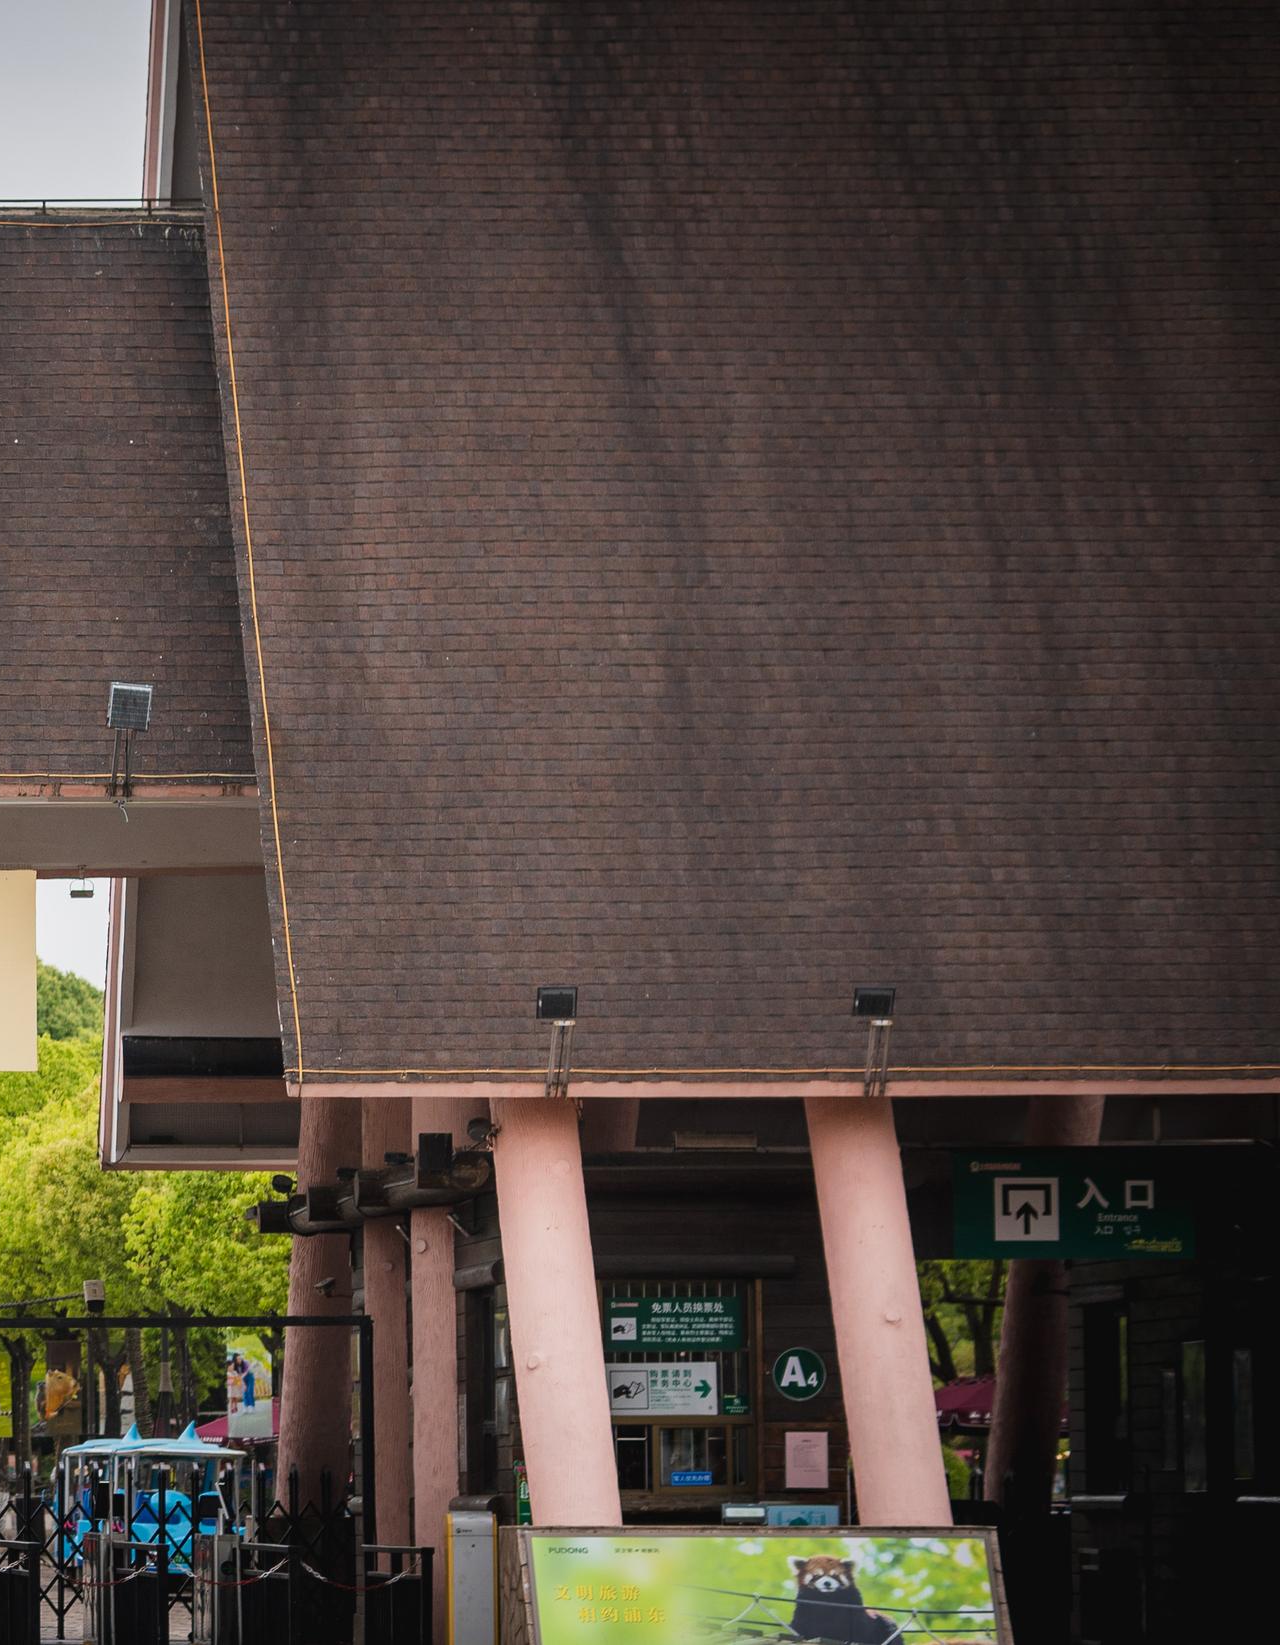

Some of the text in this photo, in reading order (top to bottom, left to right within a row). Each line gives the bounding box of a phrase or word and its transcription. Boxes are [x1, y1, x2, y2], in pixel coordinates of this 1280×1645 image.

[1076, 1177, 1156, 1210] 入口
[1097, 1212, 1139, 1222] Entrance
[651, 1302, 725, 1314] 免票人员换票处
[781, 1355, 818, 1387] A4
[548, 1546, 589, 1554] PUDONG
[555, 1584, 640, 1600] 文明旅游
[579, 1608, 665, 1623] 相约浦东
